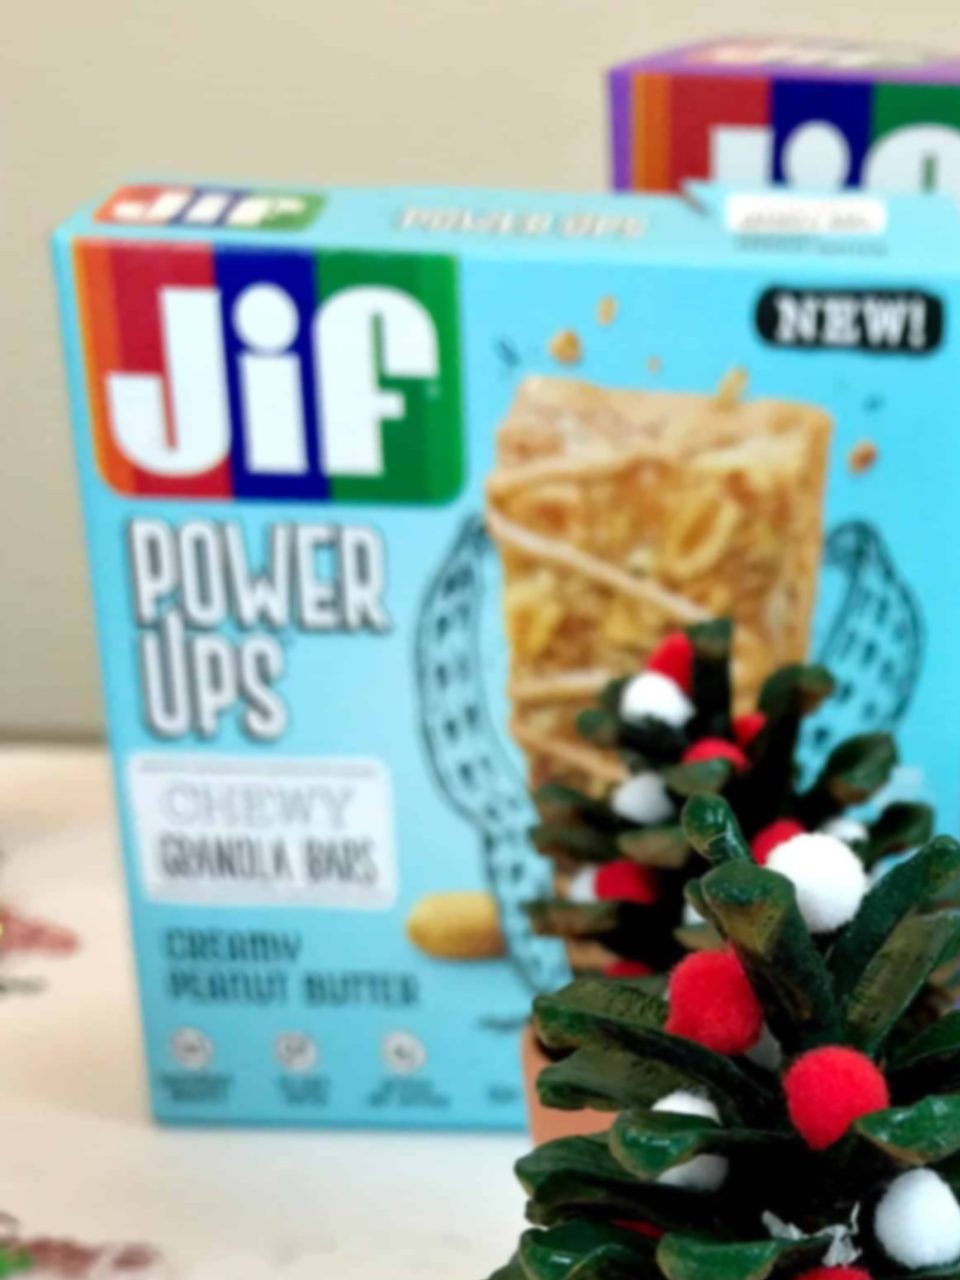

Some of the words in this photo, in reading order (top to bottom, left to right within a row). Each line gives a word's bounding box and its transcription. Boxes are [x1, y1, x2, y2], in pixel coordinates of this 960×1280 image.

[105, 283, 441, 477] Jif
[773, 292, 928, 348] NEW!
[127, 515, 390, 635] POWER
[138, 606, 288, 740] UPS
[161, 781, 356, 830] CHEWY
